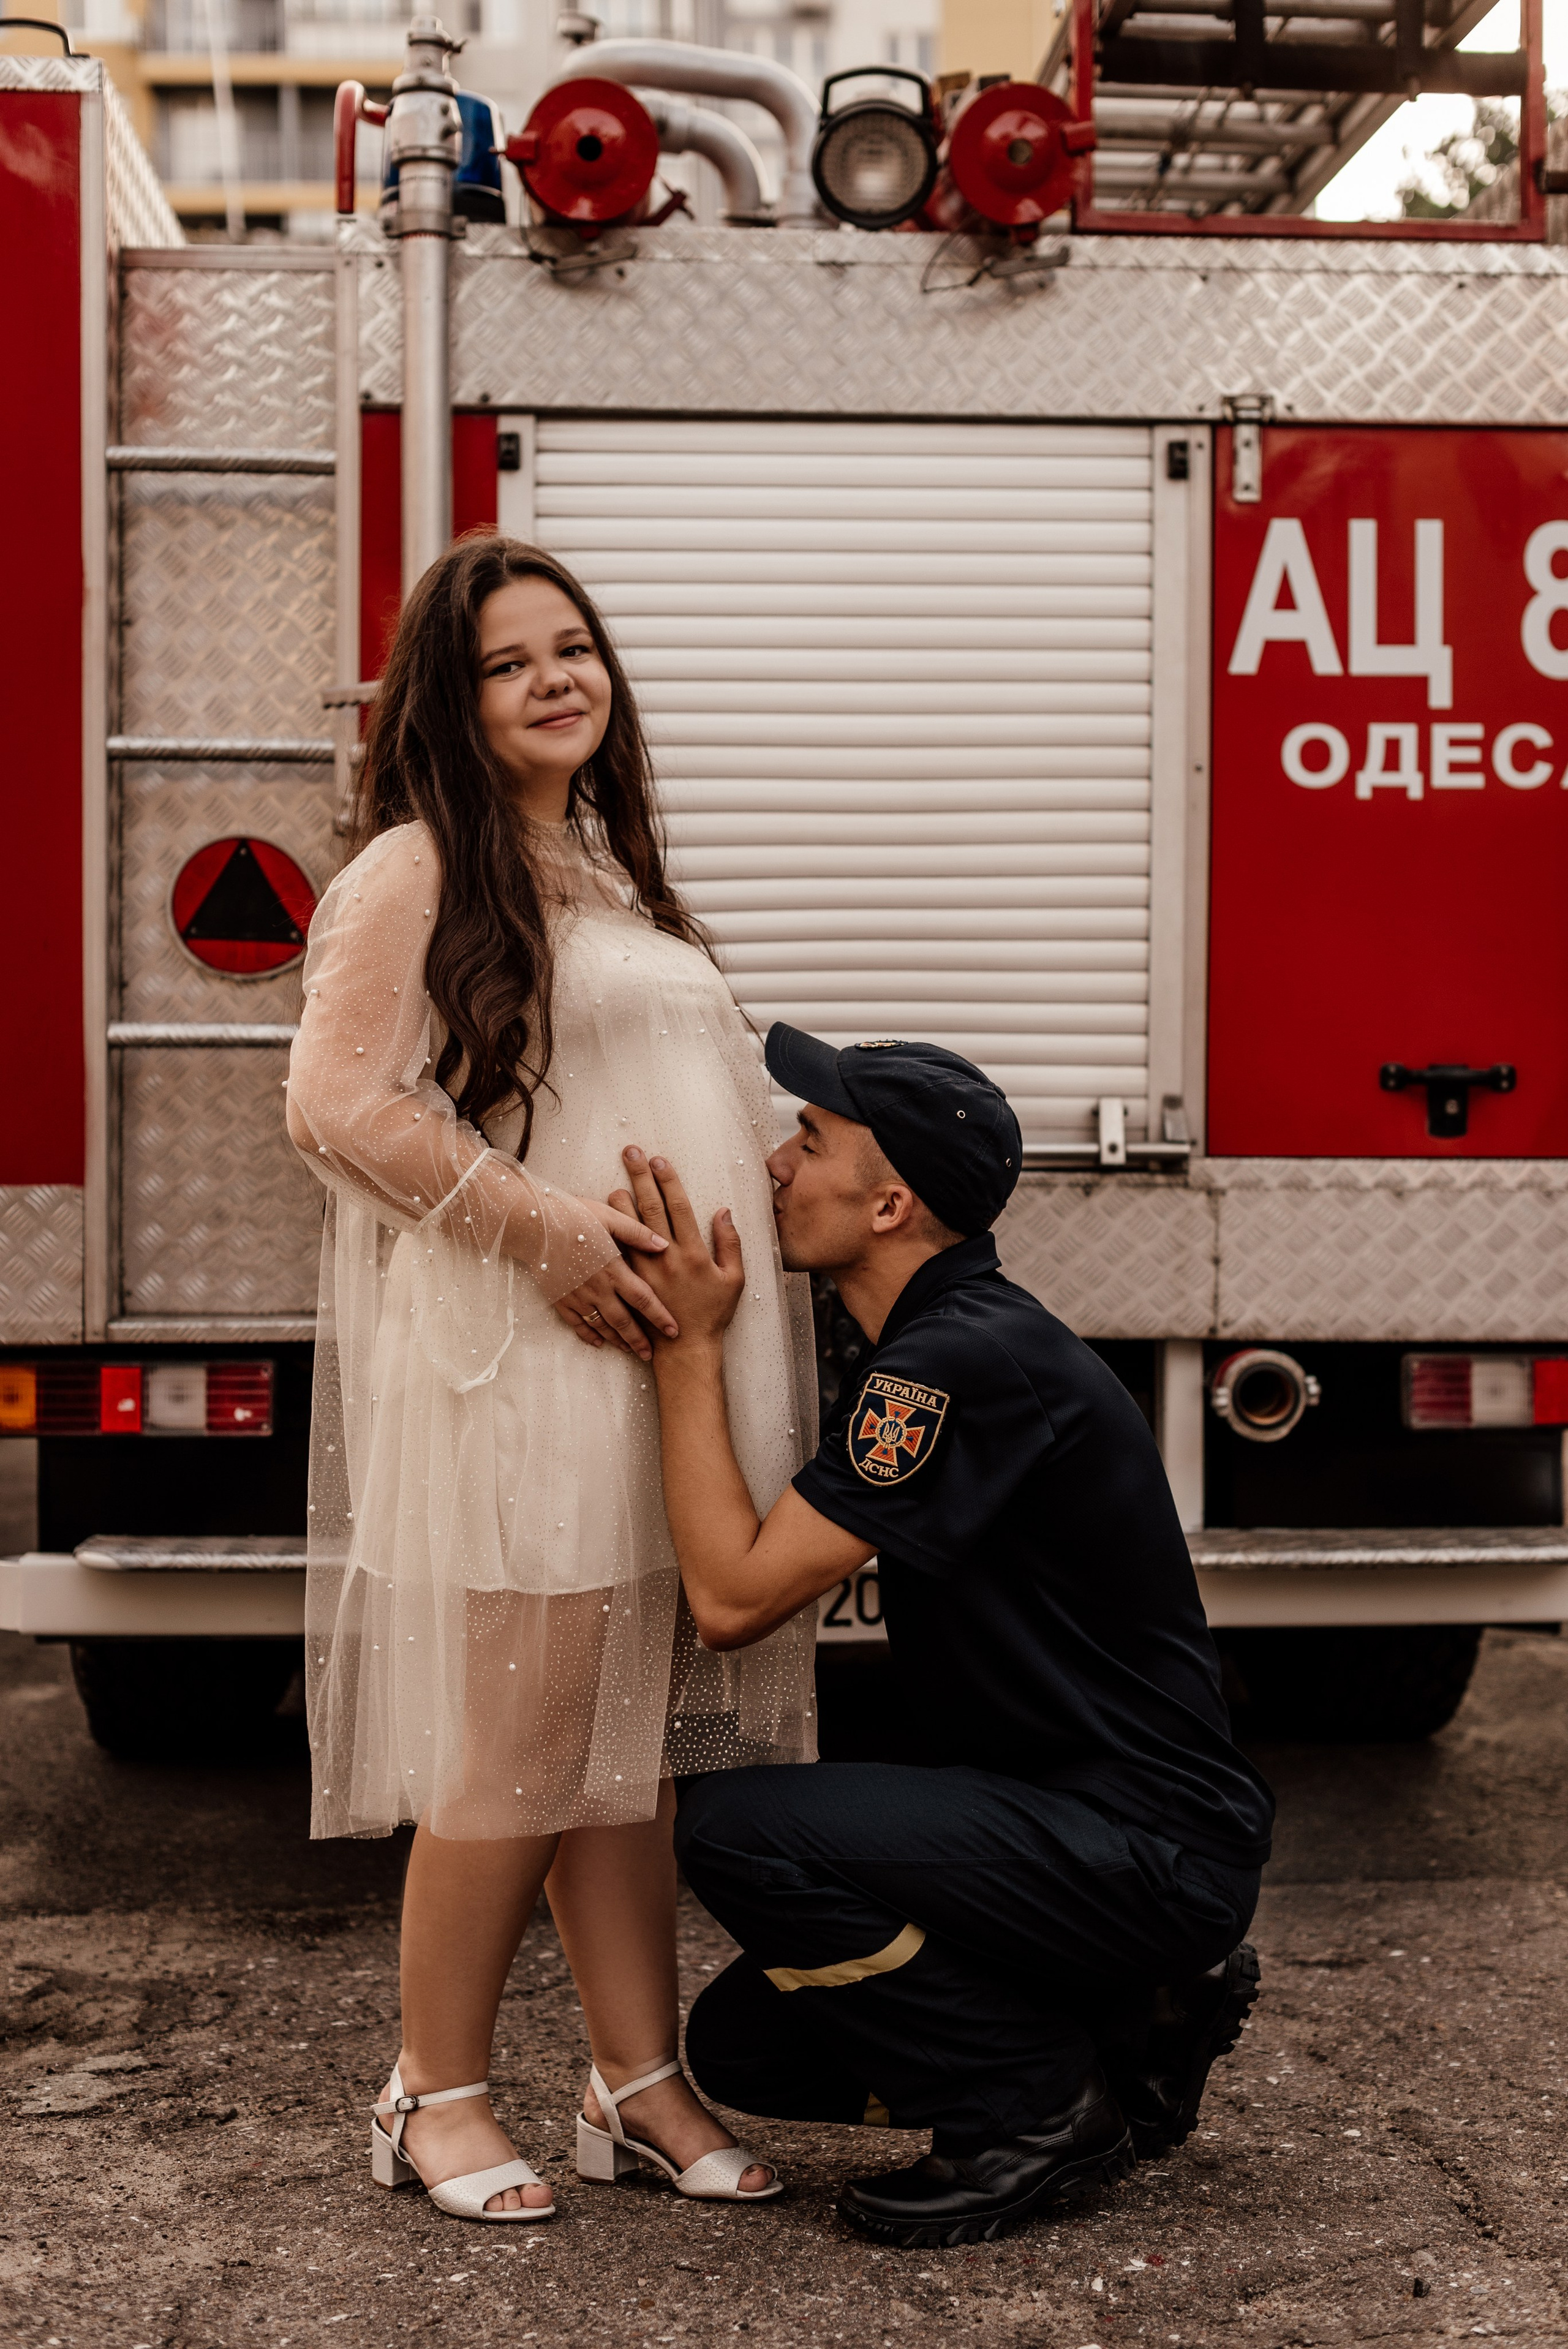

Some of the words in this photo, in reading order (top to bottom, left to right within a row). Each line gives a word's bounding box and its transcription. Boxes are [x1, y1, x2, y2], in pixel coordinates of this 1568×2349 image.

[1227, 518, 1453, 709] АЦ
[1281, 722, 1568, 800] ОДЕС
[873, 1378, 937, 1408] УКРАЇНА
[858, 1458, 899, 1478] ДСНС
[823, 1572, 883, 1627] 20
